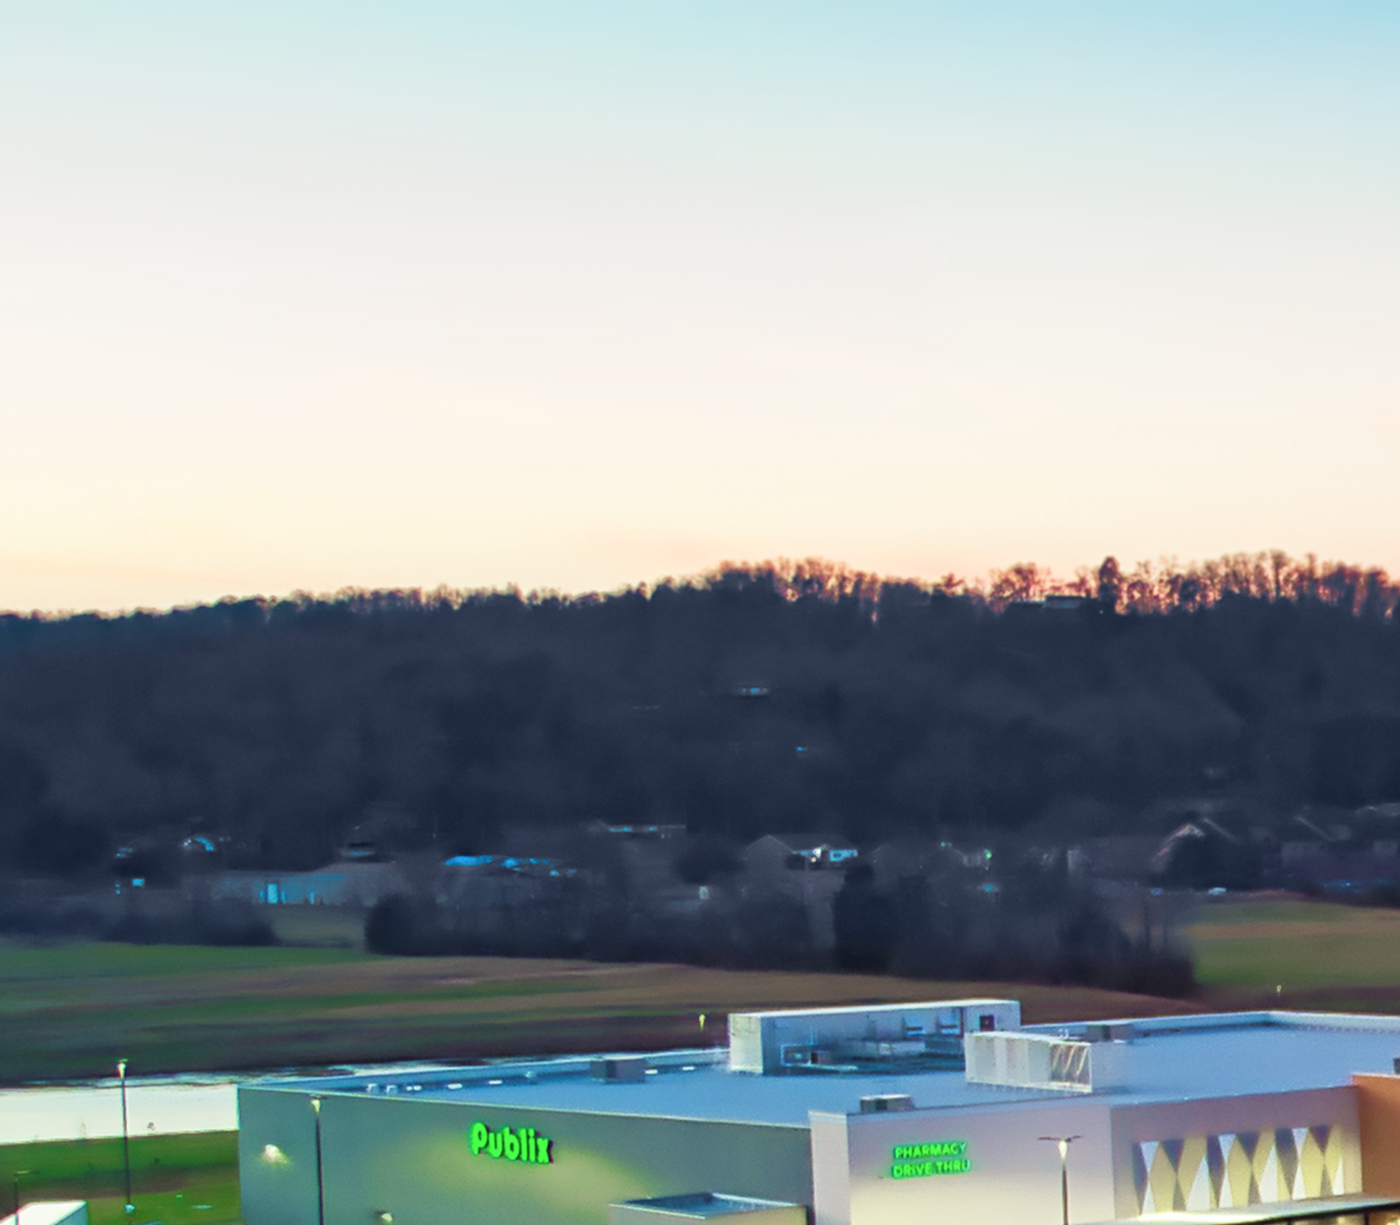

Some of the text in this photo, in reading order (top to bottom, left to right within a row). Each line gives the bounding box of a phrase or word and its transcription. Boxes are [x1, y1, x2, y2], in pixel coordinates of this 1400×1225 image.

[470, 1122, 550, 1164] Publix
[894, 1142, 967, 1159] PHARMACY
[892, 1158, 970, 1179] DRIVE THRU
